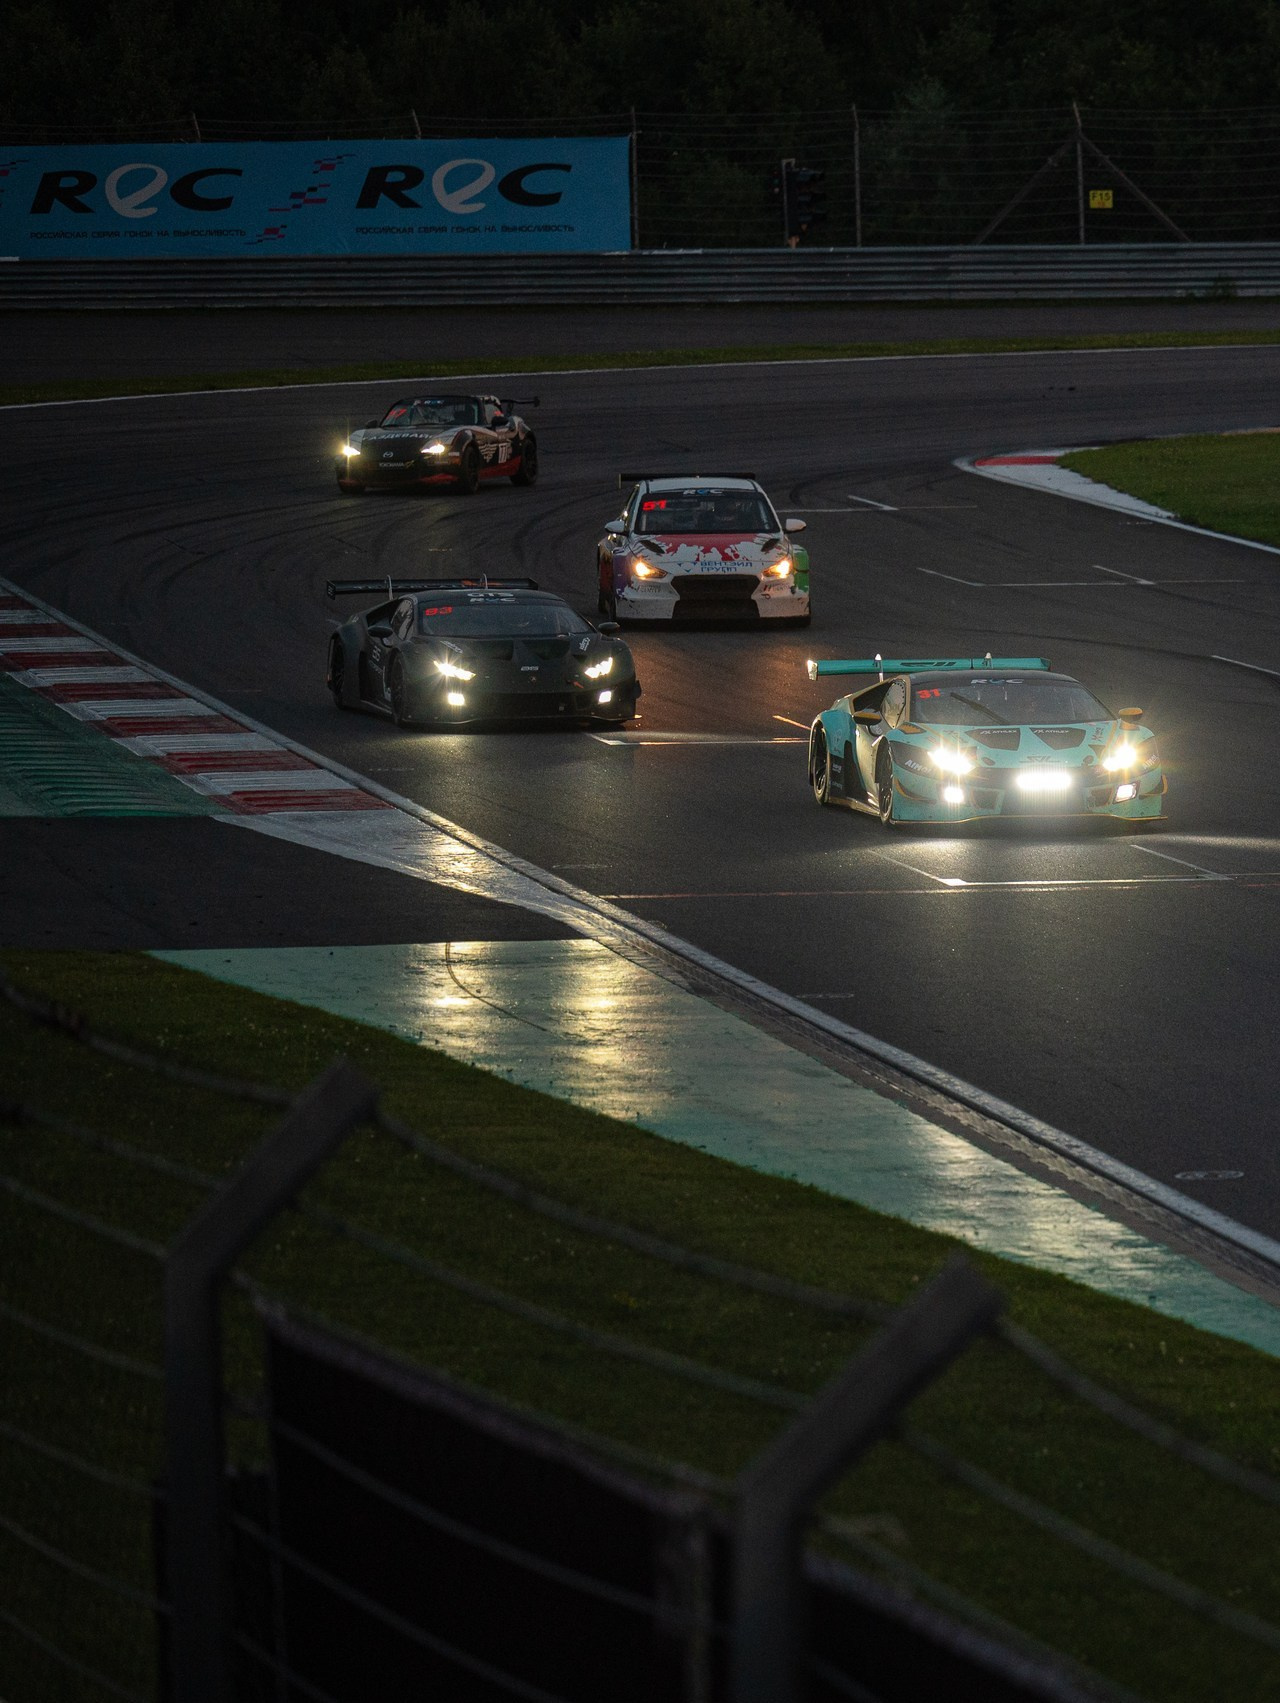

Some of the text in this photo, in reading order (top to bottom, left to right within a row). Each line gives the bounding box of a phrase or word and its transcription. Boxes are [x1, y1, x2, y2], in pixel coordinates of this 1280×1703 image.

[30, 229, 246, 240] РОССИЙСКАЯ СЕРИЯ ГОНОК НА ВЫНОСЛИВОСТЬ
[356, 224, 575, 235] РОССИЙСКАЯ СЕРИЯ ГОНОК НА ВЫНОСЛИВОСТЬ
[917, 688, 941, 699] 31
